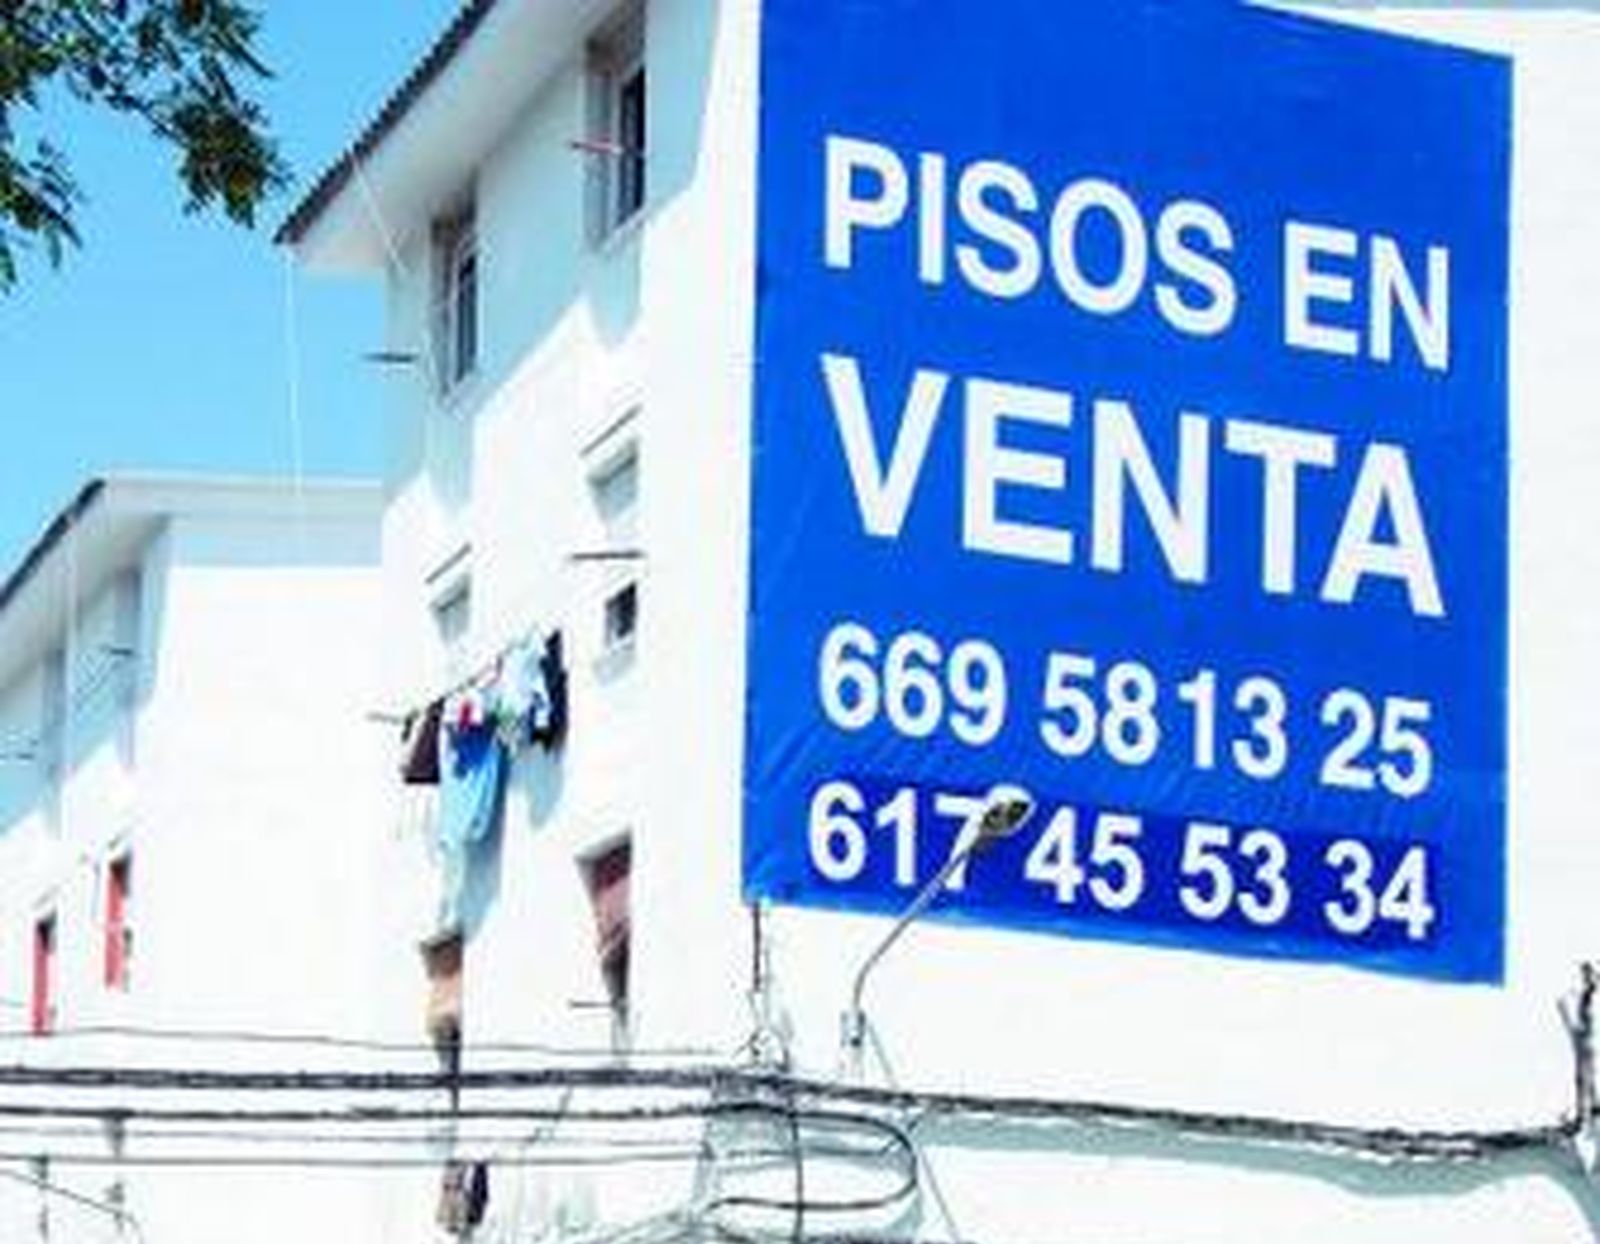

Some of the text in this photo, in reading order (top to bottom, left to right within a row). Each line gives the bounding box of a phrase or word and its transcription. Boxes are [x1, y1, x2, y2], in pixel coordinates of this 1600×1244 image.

[824, 135, 1450, 371] PISOS EN
[821, 353, 1445, 618] VENTA
[819, 622, 1006, 746] 669
[1320, 688, 1432, 798] 25
[808, 781, 1435, 940] 617 45 53 34
